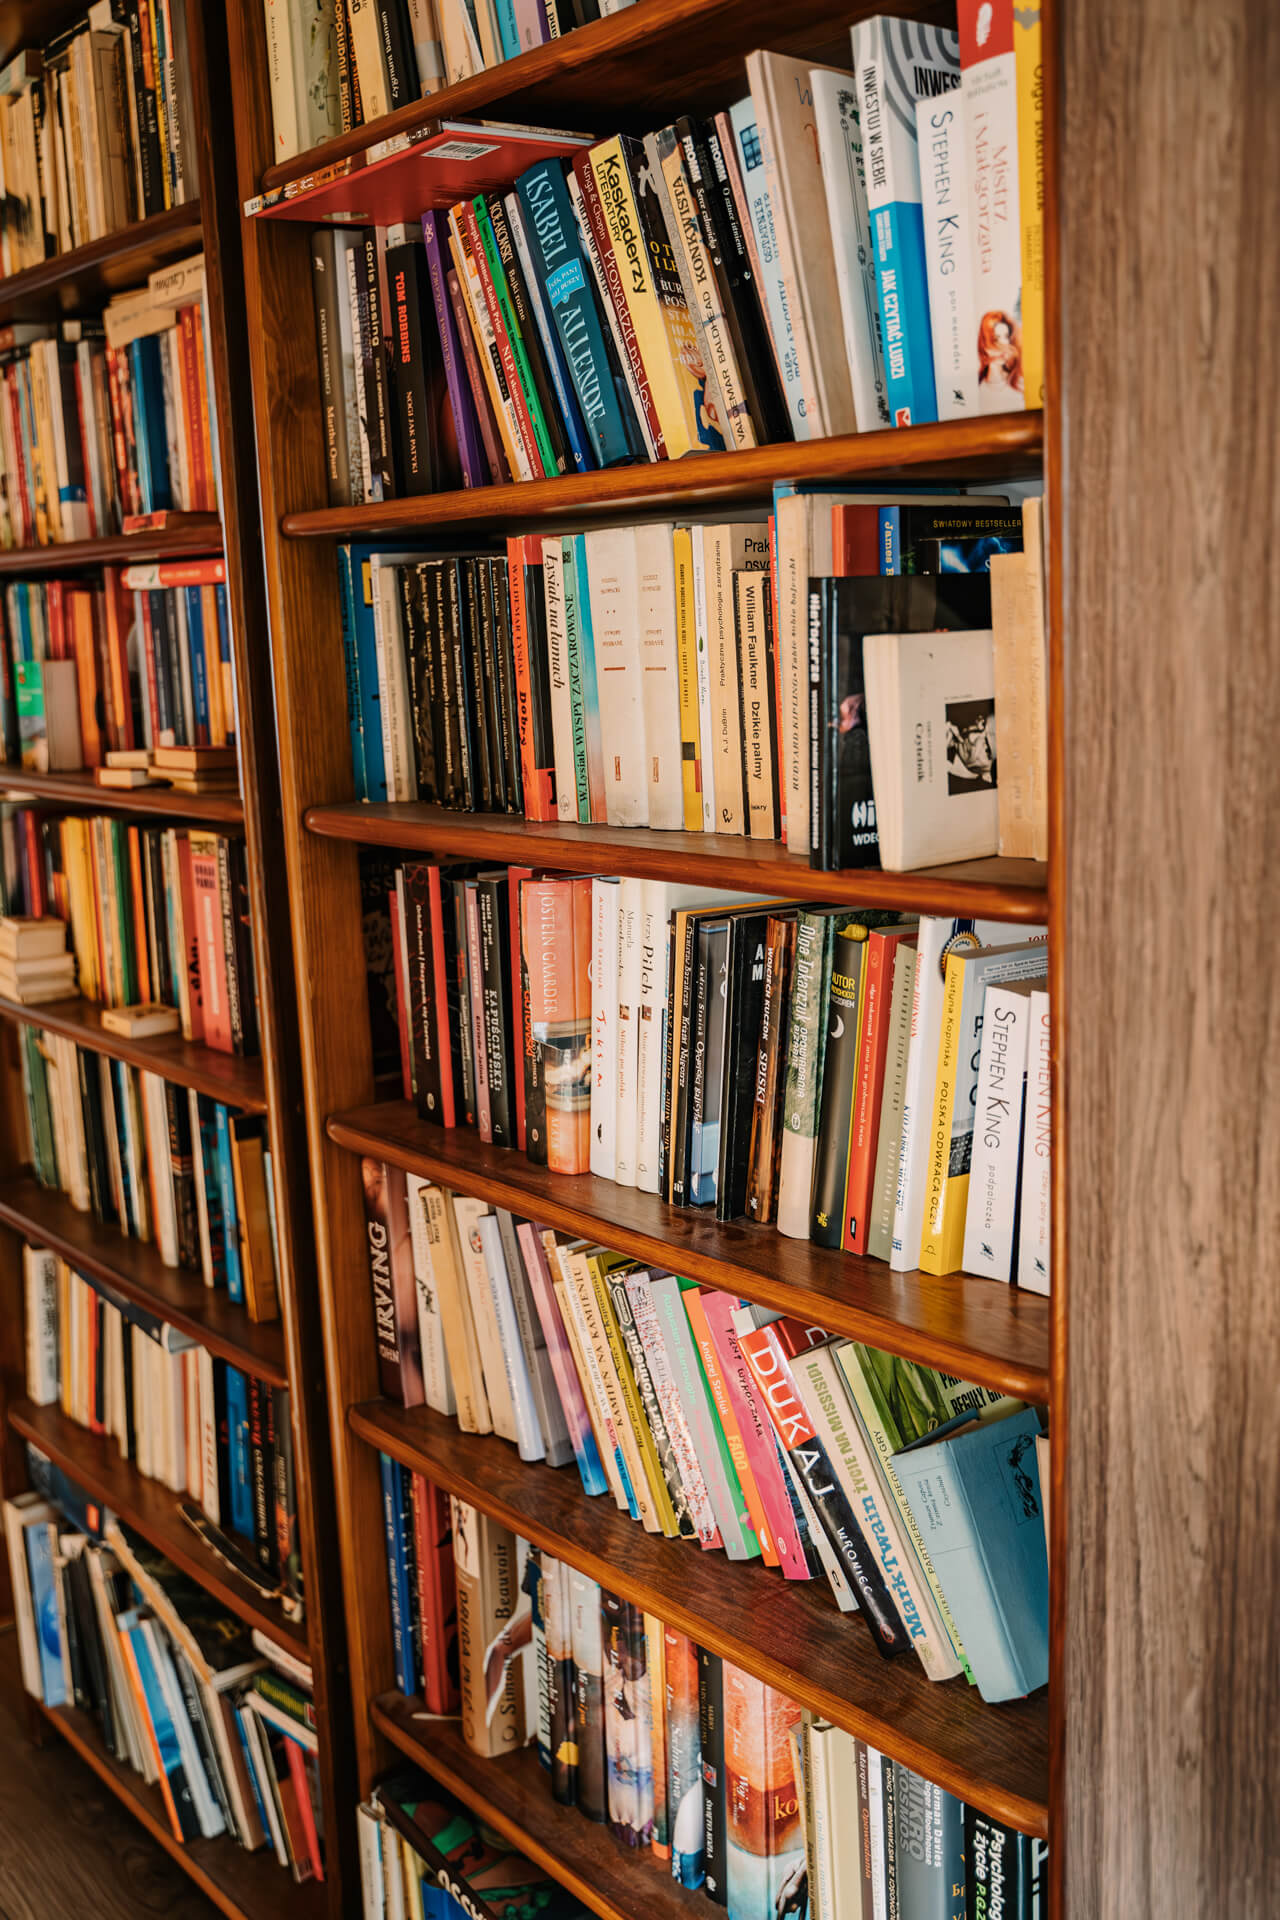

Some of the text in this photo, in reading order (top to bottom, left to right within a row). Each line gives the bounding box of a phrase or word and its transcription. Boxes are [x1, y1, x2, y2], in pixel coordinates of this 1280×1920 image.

[682, 136, 702, 183] FROMM
[708, 136, 728, 183] FROMM
[863, 66, 888, 190] INWESTUJ W SIEBIE
[525, 169, 568, 270] ISABEL
[582, 163, 606, 240] Kinga Chopin
[595, 163, 621, 242] LITERATURY
[604, 154, 647, 293] Kaskaderzy
[722, 188, 730, 196] O
[930, 110, 959, 275] STEPHEN KING
[467, 214, 479, 241] Joseph
[486, 285, 497, 311] Robin
[673, 175, 707, 283] KONKWISTA
[508, 268, 520, 291] Bajki
[948, 290, 957, 312] pan
[395, 271, 411, 363] TOM ROBBINS
[881, 269, 905, 380] JAK CZYTAĆ LUDZI
[502, 345, 514, 371] NLP
[560, 305, 607, 428] ALLENDE
[629, 346, 643, 377] nas
[640, 378, 653, 413] los
[702, 291, 746, 443] VALDEMAR BALDHEAD
[884, 521, 893, 563] James
[975, 519, 1022, 528] BESTSELLER
[550, 609, 560, 630] na
[565, 593, 584, 746] WYSPY ZACZAROWANE
[718, 642, 726, 687] Praktyczna
[745, 585, 762, 780] William Faulkner Dzikie palmy
[519, 690, 529, 746] Dobry
[792, 729, 800, 791] RUDYARD
[537, 891, 558, 1016] JOSTEIN GAARDER
[626, 911, 635, 949] Manuela
[641, 944, 655, 996] Pilch
[755, 946, 774, 1105] WOJCIECH KUCZOK SPISKI
[791, 1023, 801, 1068] BIZARNE
[796, 924, 816, 1098] Olga Tokarczuk OPOWIADANIA
[931, 970, 958, 1193] Justyna Kopińska POLSKA ODWRACA
[984, 1007, 1017, 1149] STEPHEN KING
[663, 1088, 672, 1154] Alice Miller
[1035, 1104, 1052, 1158] KING
[984, 1165, 998, 1230] podpalaczka
[367, 1221, 396, 1345] IRVING
[596, 1346, 607, 1363] NA
[626, 1328, 668, 1440] Kurt Vonnegut
[701, 1340, 716, 1378] Andrzej
[711, 1379, 729, 1416] Stasiuk
[727, 1434, 748, 1471] FADO
[872, 1429, 889, 1453] GRY
[806, 1362, 919, 1640] Mark Twain ŻYCIE NA MISSISIPI
[900, 1499, 936, 1575] PARTNERSKIE
[494, 1543, 512, 1620] Beauvoir
[836, 1525, 875, 1596] WRONIEC
[459, 1589, 471, 1657] DRUGA
[862, 1807, 873, 1880] Opowiadania
[908, 1774, 924, 1861] MIKRO
[924, 1808, 934, 1866] Moorhouse
[933, 1828, 943, 1868] Davies
[974, 1830, 990, 1881] życie
